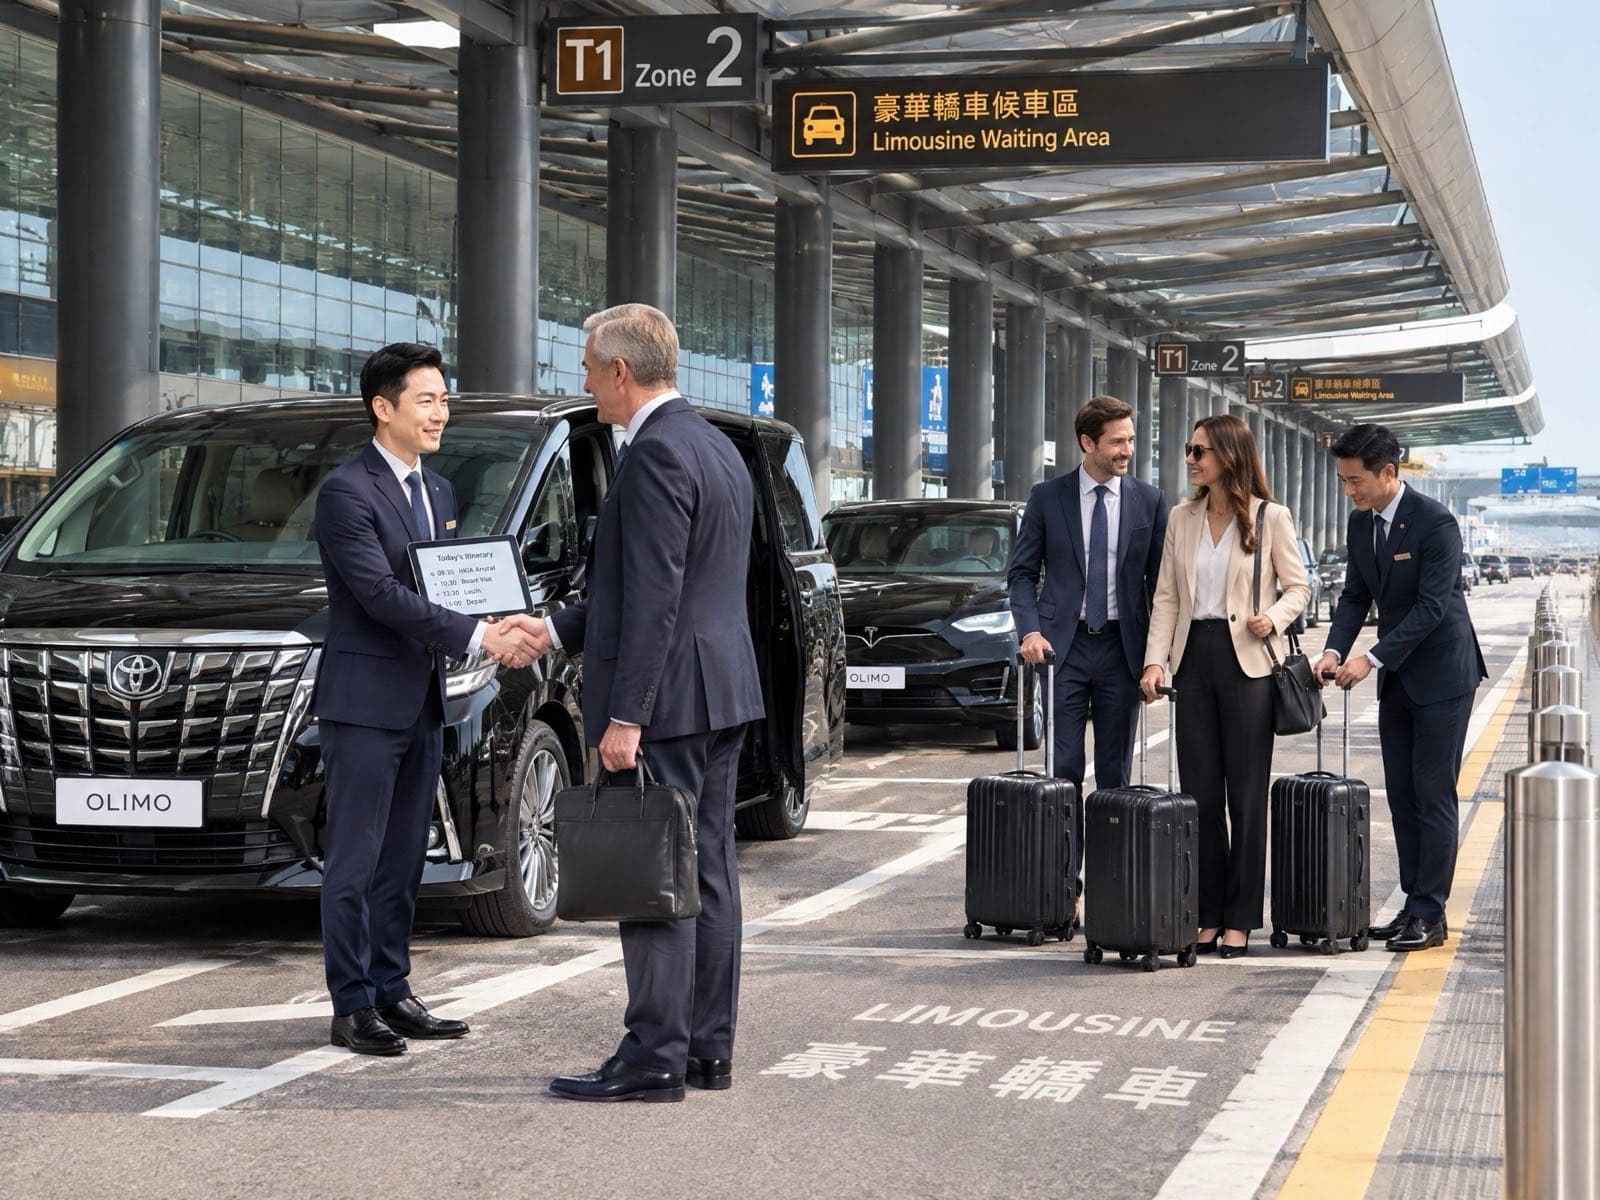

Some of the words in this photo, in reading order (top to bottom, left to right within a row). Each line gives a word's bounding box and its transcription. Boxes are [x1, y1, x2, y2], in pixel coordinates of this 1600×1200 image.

[565, 38, 612, 82] T1
[635, 63, 697, 88] Zone
[706, 26, 742, 87] 2
[873, 89, 1079, 123] 豪華轎車候車區
[873, 130, 976, 152] Limousine
[981, 128, 1058, 152] Waiting
[1063, 127, 1110, 147] Area
[1162, 350, 1183, 369] T1
[1191, 360, 1218, 371] Zone
[1222, 345, 1239, 372] 2
[850, 673, 891, 683] OLIMO
[86, 793, 172, 812] OLIMO
[853, 1003, 1237, 1043] LIMOUSINE
[758, 1041, 1208, 1110] 豪華轎車
